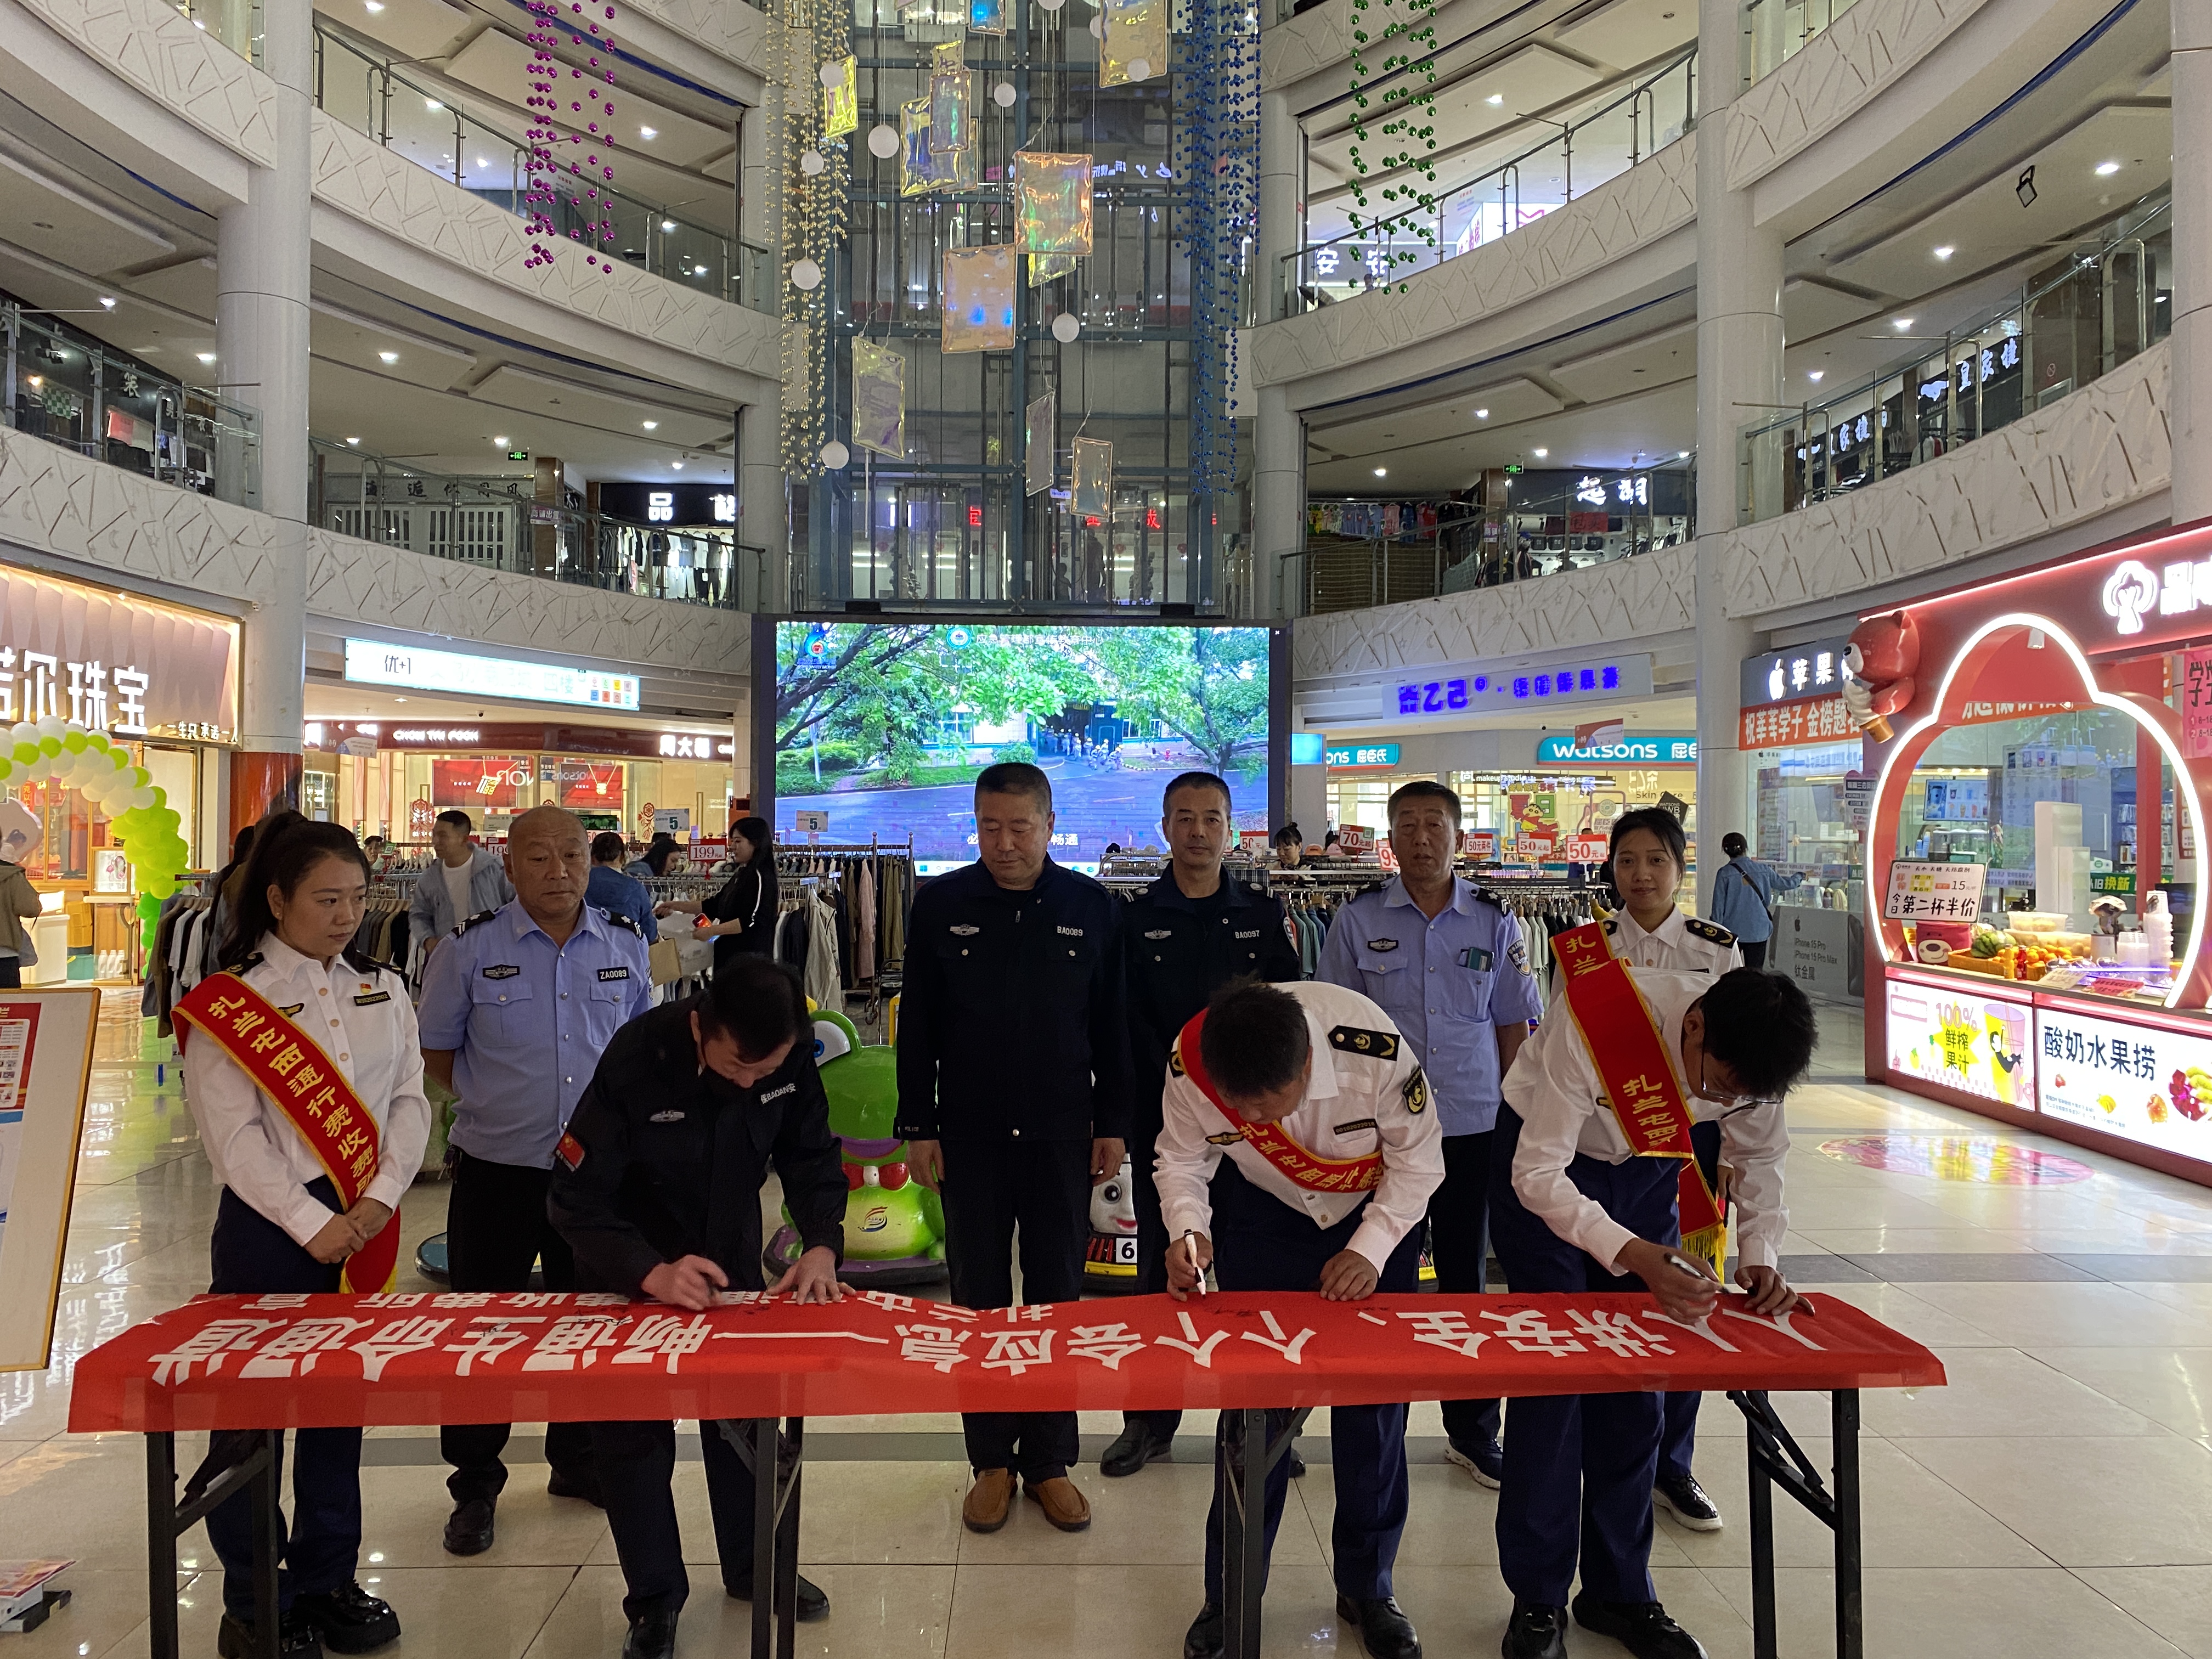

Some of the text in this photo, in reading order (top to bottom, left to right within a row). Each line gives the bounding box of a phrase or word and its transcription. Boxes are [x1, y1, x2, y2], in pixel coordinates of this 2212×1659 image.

[1745, 705, 1803, 746] 祝莘莘学子
[1357, 749, 1387, 764] 屈臣氏
[1476, 774, 1502, 783] makeup
[669, 816, 678, 830] 5
[809, 817, 817, 830] 5
[1468, 841, 1491, 851] 50元两件
[1951, 881, 1966, 890] 15
[1902, 895, 1976, 917] 第二杯半价
[1057, 926, 1084, 936] BA0089
[1234, 930, 1260, 939] BA0097
[599, 969, 627, 980] ZA0089
[1936, 1002, 1978, 1033] 100%
[1945, 1028, 1969, 1052] 鲜榨
[2044, 1025, 2155, 1081] 酸奶水果捞
[1946, 1050, 1970, 1074] 果汁
[207, 995, 376, 1198] 扎兰屯西通行费收费所
[1121, 1242, 1135, 1259] 6
